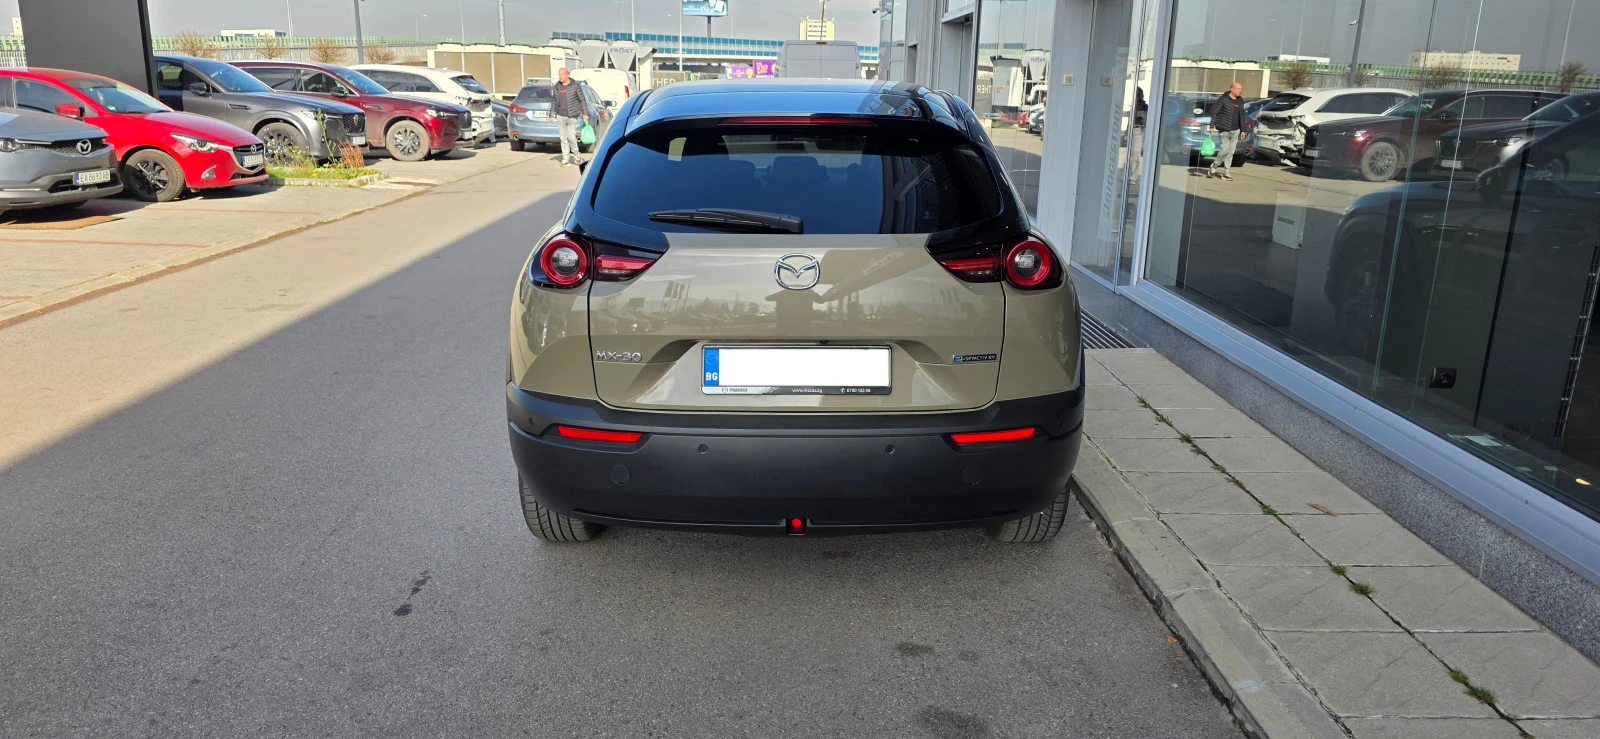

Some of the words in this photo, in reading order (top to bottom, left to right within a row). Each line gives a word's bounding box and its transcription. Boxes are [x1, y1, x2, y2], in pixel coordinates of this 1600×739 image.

[609, 47, 634, 55] FROST
[1104, 101, 1121, 219] BRIDGESTONE
[596, 350, 642, 361] MX-30
[705, 372, 719, 381] BG
